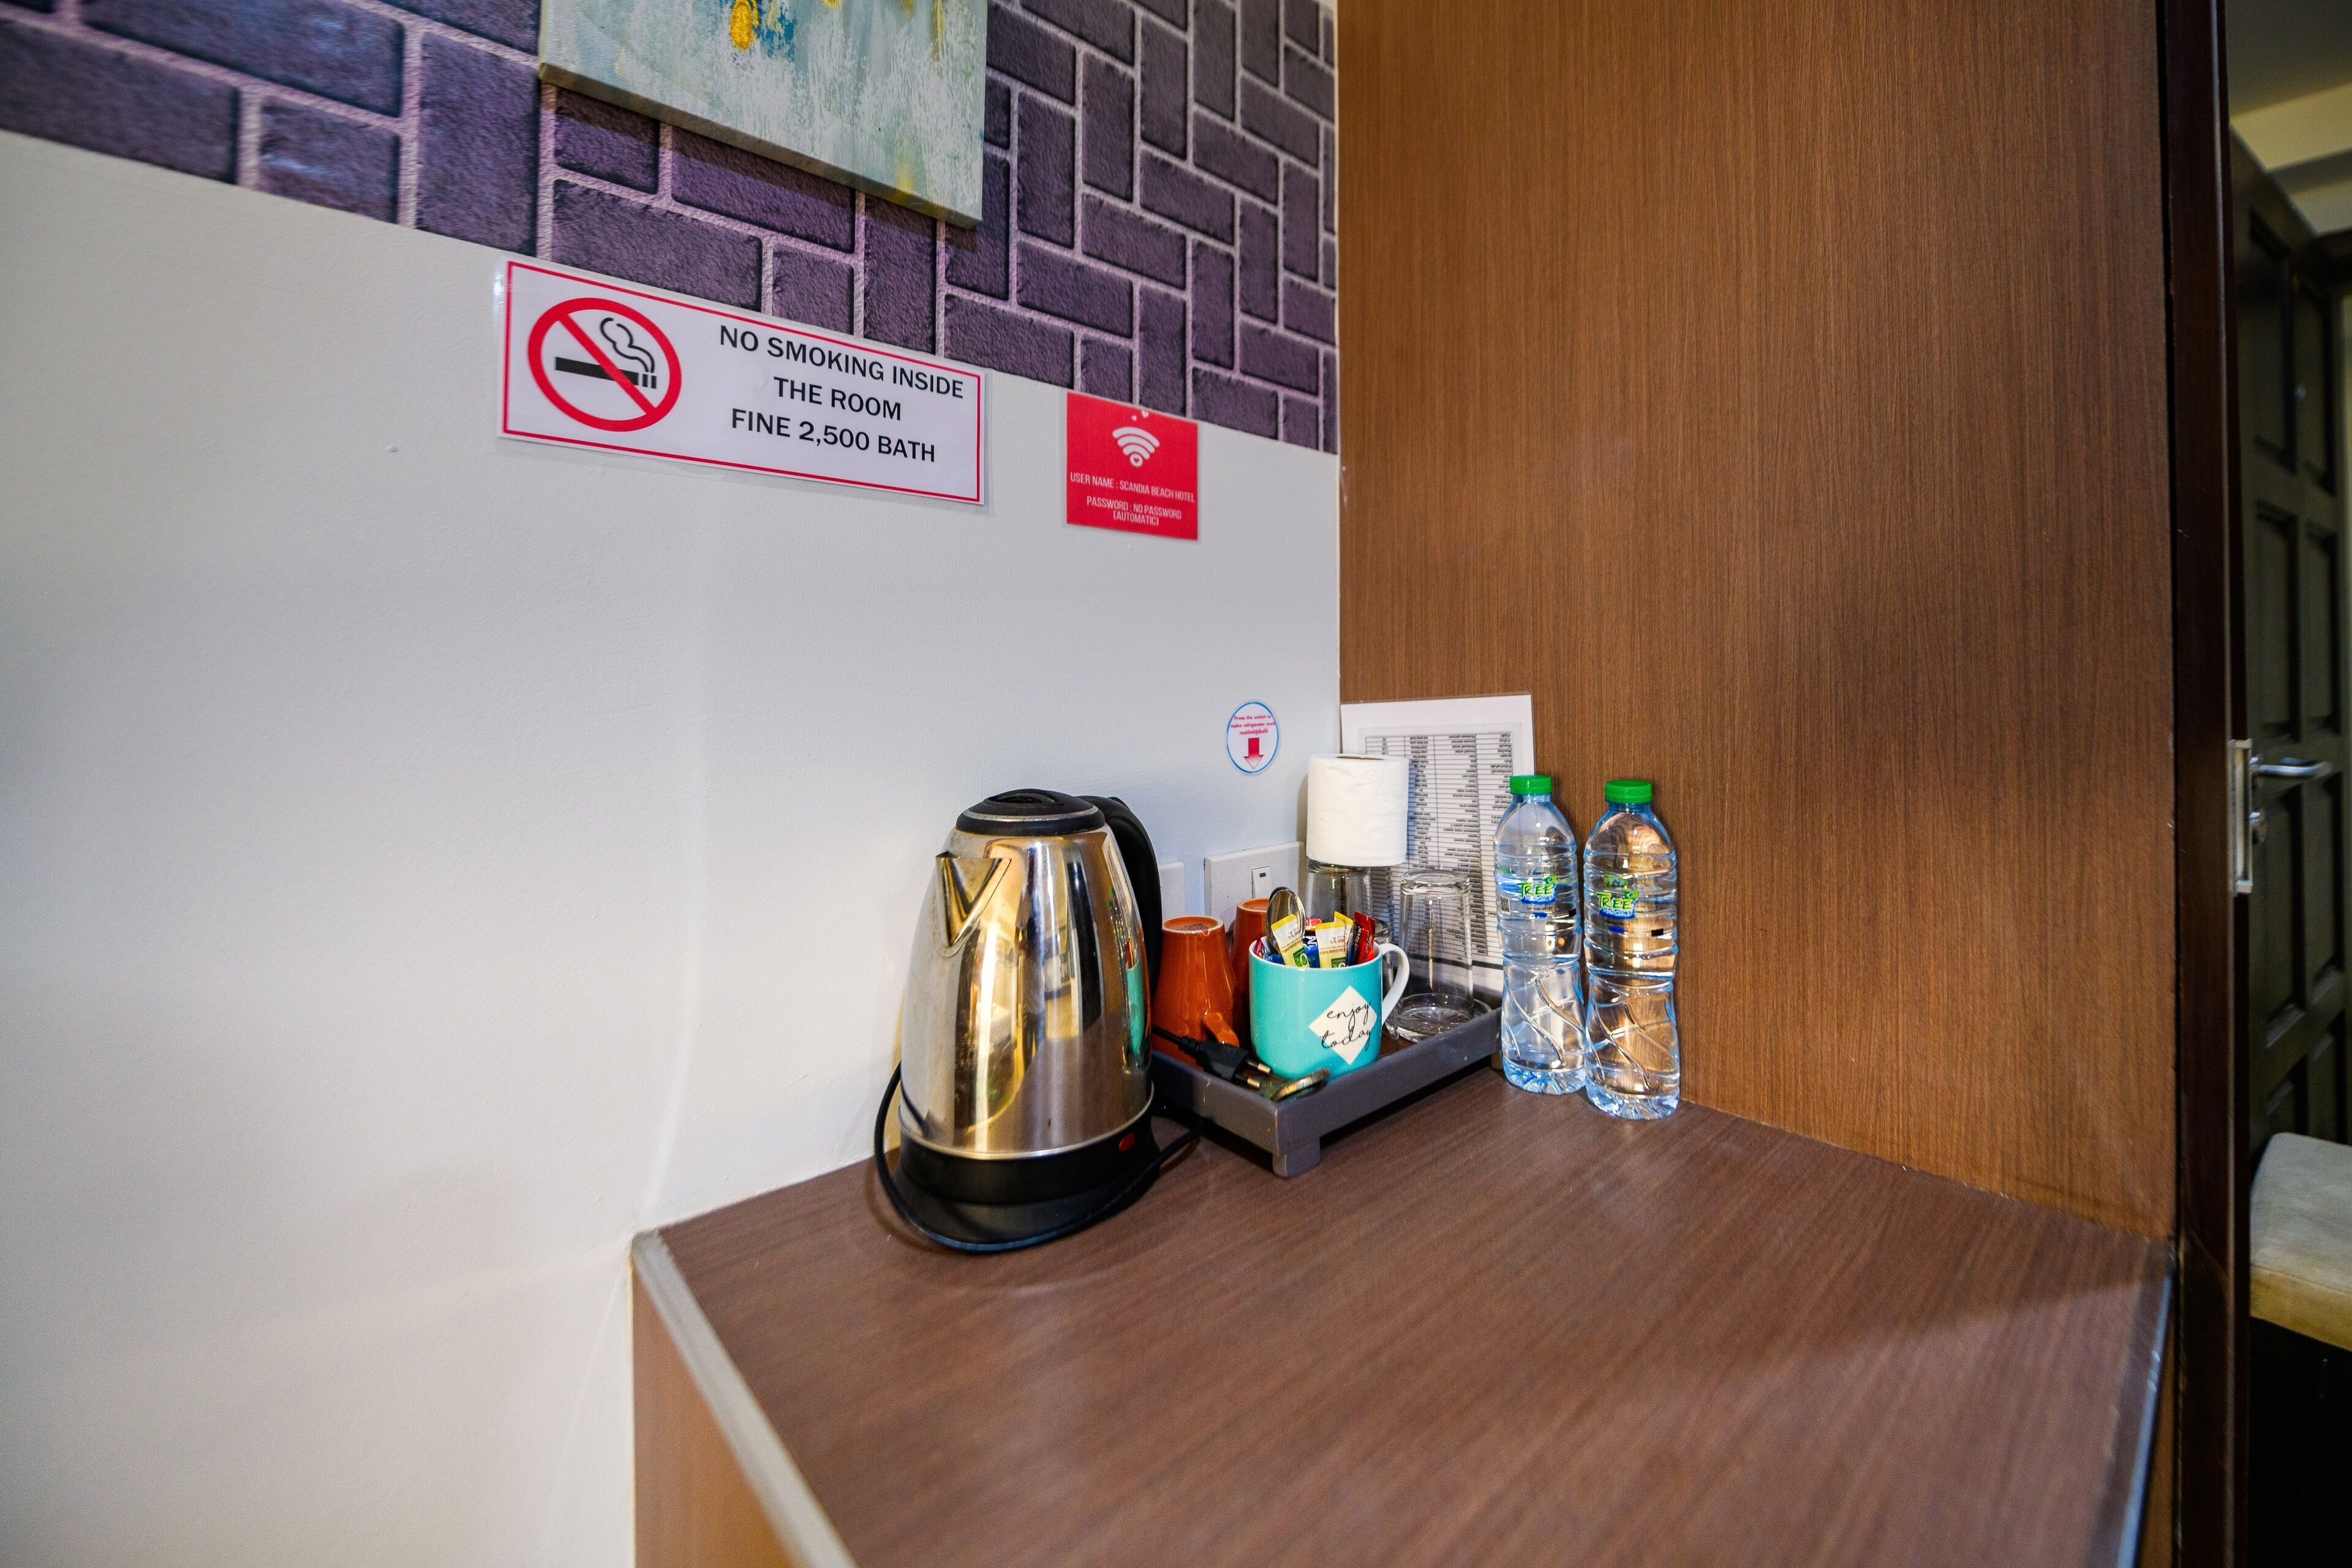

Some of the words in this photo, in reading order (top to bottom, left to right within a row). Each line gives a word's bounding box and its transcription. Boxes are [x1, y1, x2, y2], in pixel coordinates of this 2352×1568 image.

[720, 325, 758, 352] NO
[767, 337, 885, 381] SMOKING
[892, 364, 965, 399] INSIDE
[774, 376, 823, 405] THE
[831, 388, 903, 421] ROOM
[732, 408, 791, 438] FINE
[799, 421, 870, 451] 2,500
[878, 435, 935, 462] BATH
[1070, 472, 1090, 484] USER
[1092, 475, 1114, 488] NAME
[1120, 480, 1150, 494] SCANDIA
[1152, 485, 1174, 497] BEACH
[1175, 492, 1195, 502] HOTEL
[1087, 496, 1128, 511] PASSWORD
[1133, 503, 1143, 512] NO
[1144, 506, 1182, 519] PASSWORD
[1113, 510, 1159, 526] (AUTOMATIC)
[1517, 882, 1552, 898] TREE
[1596, 892, 1634, 910] TREE
[1327, 1001, 1372, 1032] enjoy
[1321, 1026, 1374, 1052] today
